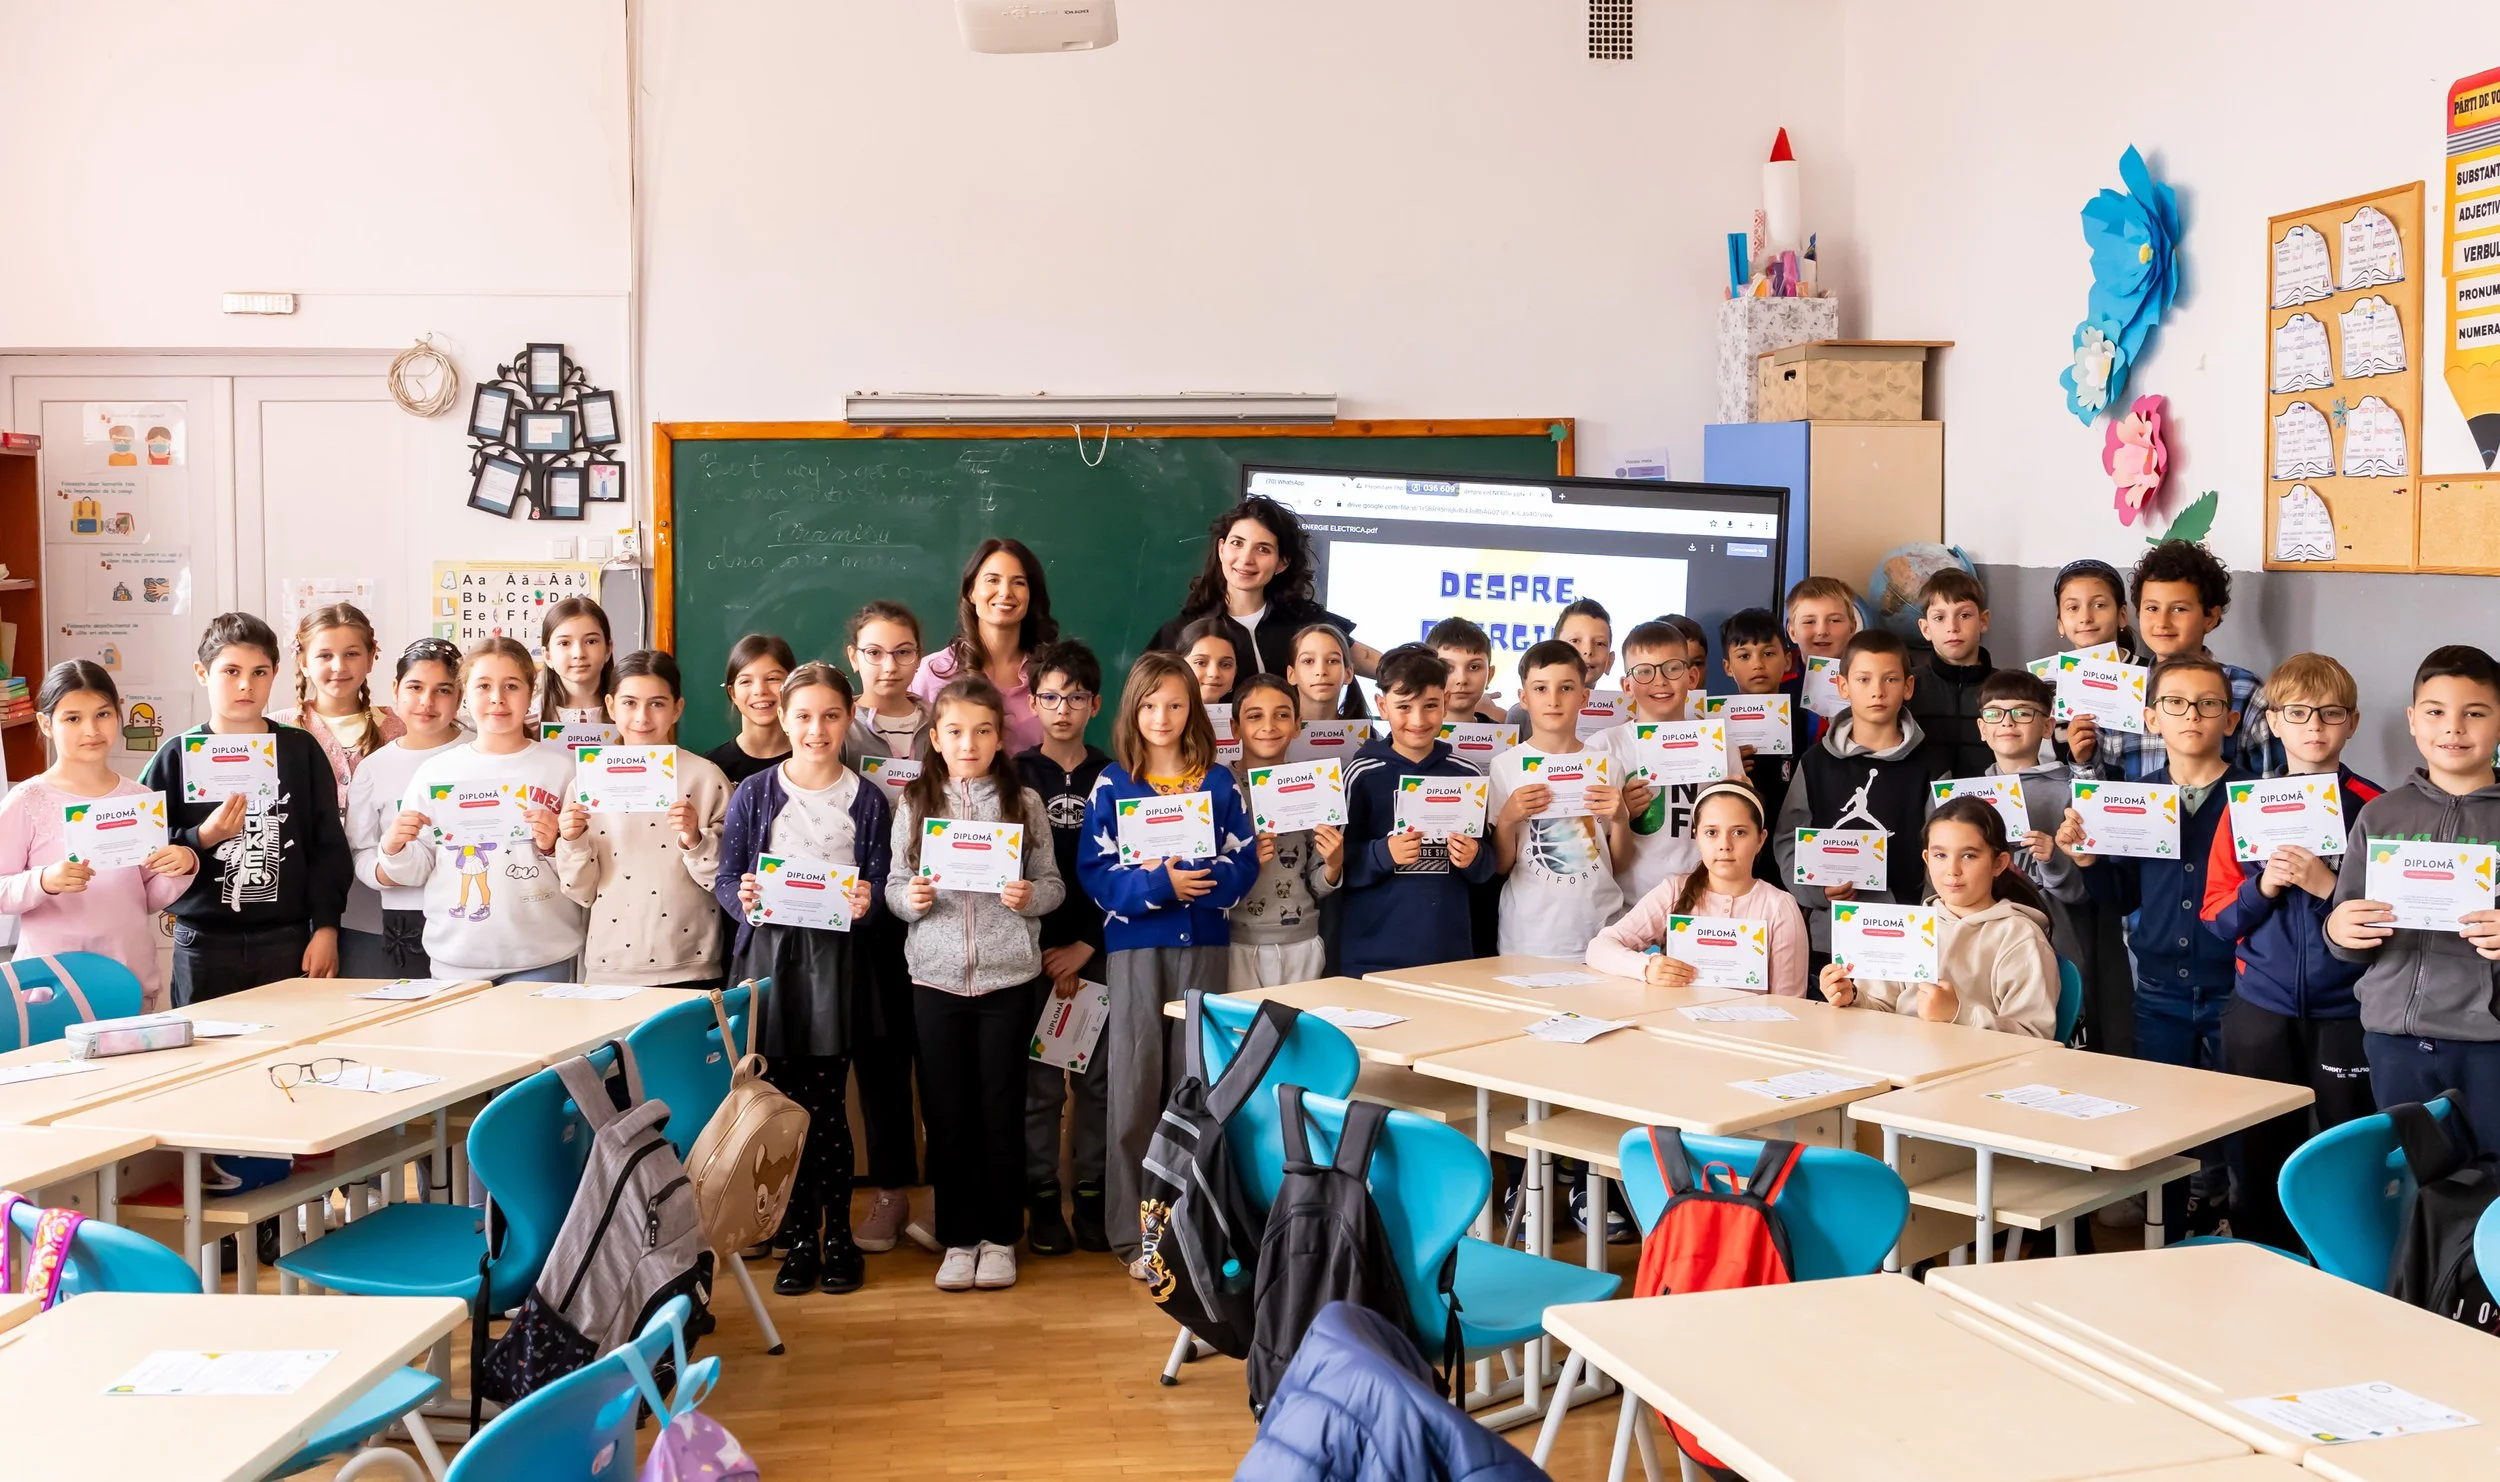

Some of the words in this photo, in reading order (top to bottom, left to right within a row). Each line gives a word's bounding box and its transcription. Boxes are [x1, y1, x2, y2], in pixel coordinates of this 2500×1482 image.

[2479, 93, 2489, 108] DE
[2456, 162, 2500, 186] SUBSTANT
[2458, 199, 2500, 222] ADJECTIV
[2464, 241, 2500, 262] VERBUL
[2459, 284, 2500, 301] PRONUM
[2459, 323, 2500, 339] NUMERA
[1301, 523, 1329, 533] ENERGIE
[1330, 524, 1378, 535] ELECTRICA.pdf
[463, 575, 473, 585] A
[478, 577, 486, 585] a
[1440, 570, 1574, 603] DESPRE
[463, 593, 472, 602] B
[478, 592, 486, 602] b
[506, 593, 516, 603] C
[550, 593, 559, 602] D
[463, 610, 472, 620] E
[478, 612, 486, 620] e
[507, 610, 515, 620] F
[523, 610, 528, 620] f
[463, 628, 472, 638] H
[2083, 670, 2119, 682] DIPLOMĂ
[1587, 701, 1614, 709] PLOMĂ
[1730, 704, 1765, 713] DIPLOMĂ
[567, 734, 602, 743] DIPLOMĂ
[1310, 729, 1345, 738] DIPLOMĂ
[1458, 734, 1493, 743] DIPLOMĂ
[1662, 731, 1698, 741] DIPLOMĂ
[212, 746, 249, 754] DIPLOMĂ
[606, 756, 647, 765] DIPLOMĂ
[1548, 763, 1584, 773] DIPLOMĂ
[887, 769, 920, 780] DIPLOM
[1277, 773, 1314, 785] DIPLOMĂ
[459, 790, 499, 801] DIPLOMĂ
[1426, 787, 1462, 796] DIPLOMĂ
[2260, 790, 2304, 804] DIPLOMĂ
[2104, 795, 2146, 806] DIPLOMĂ
[96, 807, 137, 822] DIPLOMĂ
[1145, 805, 1183, 816] DIPLOMĂ
[953, 832, 993, 842] DIPLOMĂ
[1823, 838, 1859, 847] DIPLOMĂ
[2404, 858, 2454, 869] DIPLOMĂ
[786, 871, 827, 882] DIPLOMĂ
[1862, 918, 1905, 928] DIPLOMĂ
[1697, 928, 1737, 938] DIPLOMĂ
[1047, 1002, 1065, 1036] DIPLOMĂ
